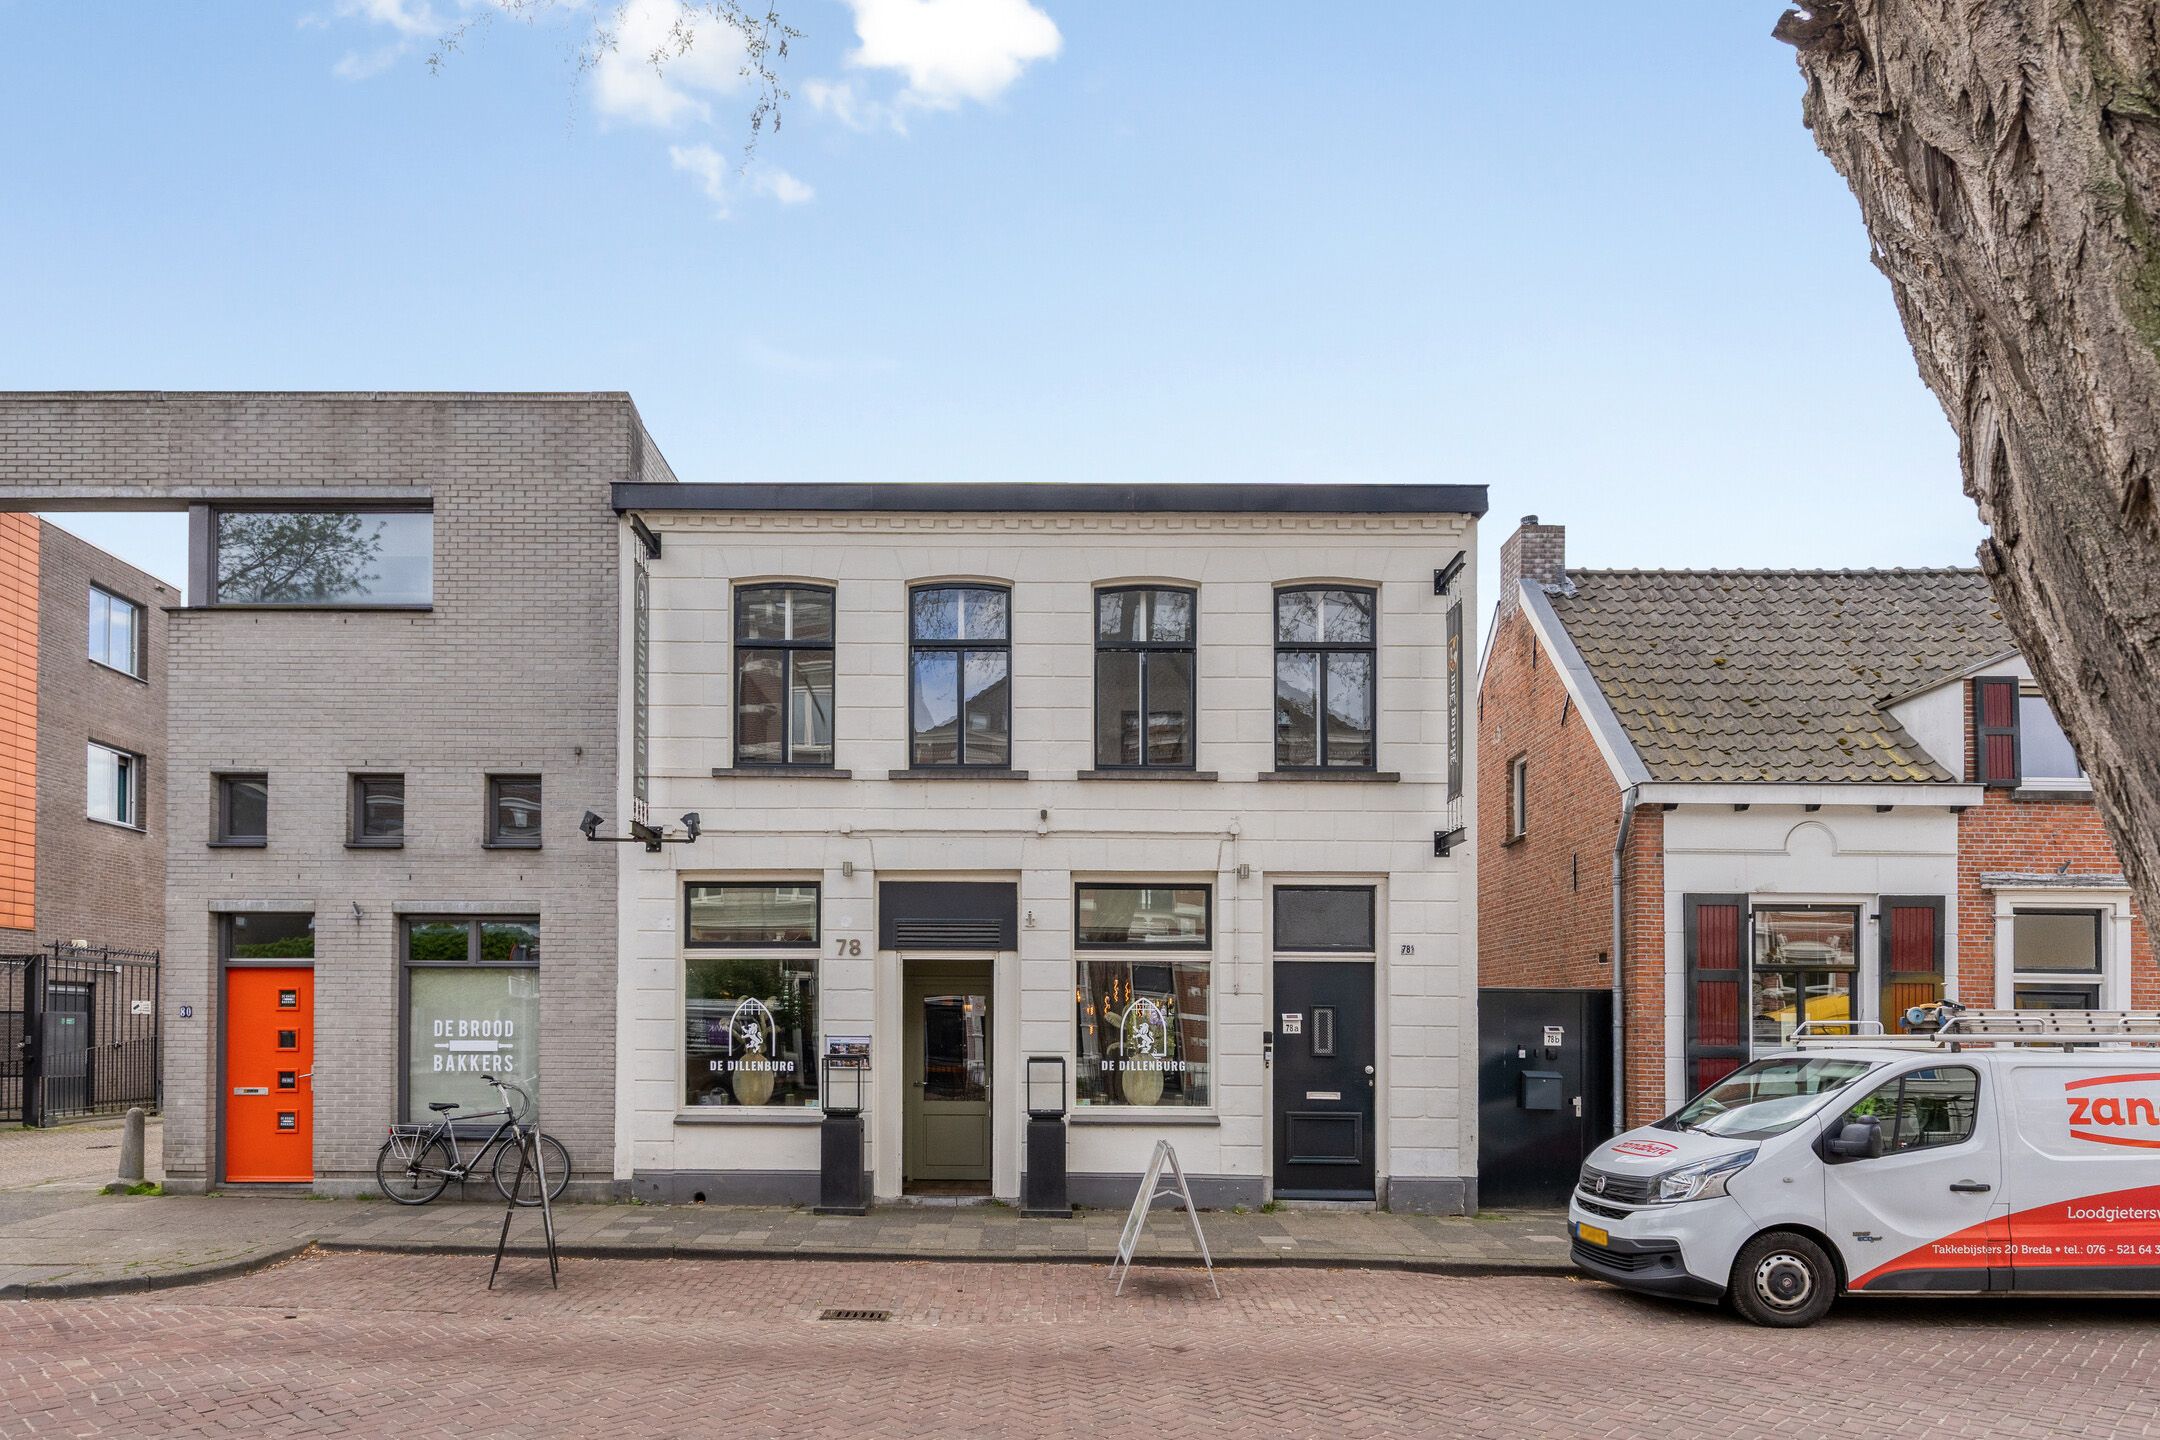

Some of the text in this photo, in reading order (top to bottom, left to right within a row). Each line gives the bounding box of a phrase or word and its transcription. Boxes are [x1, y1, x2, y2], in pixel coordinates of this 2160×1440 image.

[637, 615, 647, 791] DE DILLENBURG
[836, 938, 861, 956] 78
[179, 1005, 192, 1018] 80
[434, 1019, 514, 1037] DE BROOD
[433, 1054, 514, 1073] BAKKERS
[709, 1060, 795, 1072] DE DILLENBURG
[1101, 1060, 1186, 1072] DE DILLENBURG
[2065, 1097, 2160, 1126] zan
[2067, 1206, 2160, 1222] Loodgieters
[1932, 1244, 2002, 1256] Takkebijsters
[2004, 1244, 2018, 1254] 20
[2021, 1244, 2052, 1254] Breda
[2063, 1244, 2083, 1254] tel.:
[2086, 1244, 2106, 1254] 076
[2116, 1244, 2136, 1255] 521
[2138, 1244, 2152, 1255] 64
